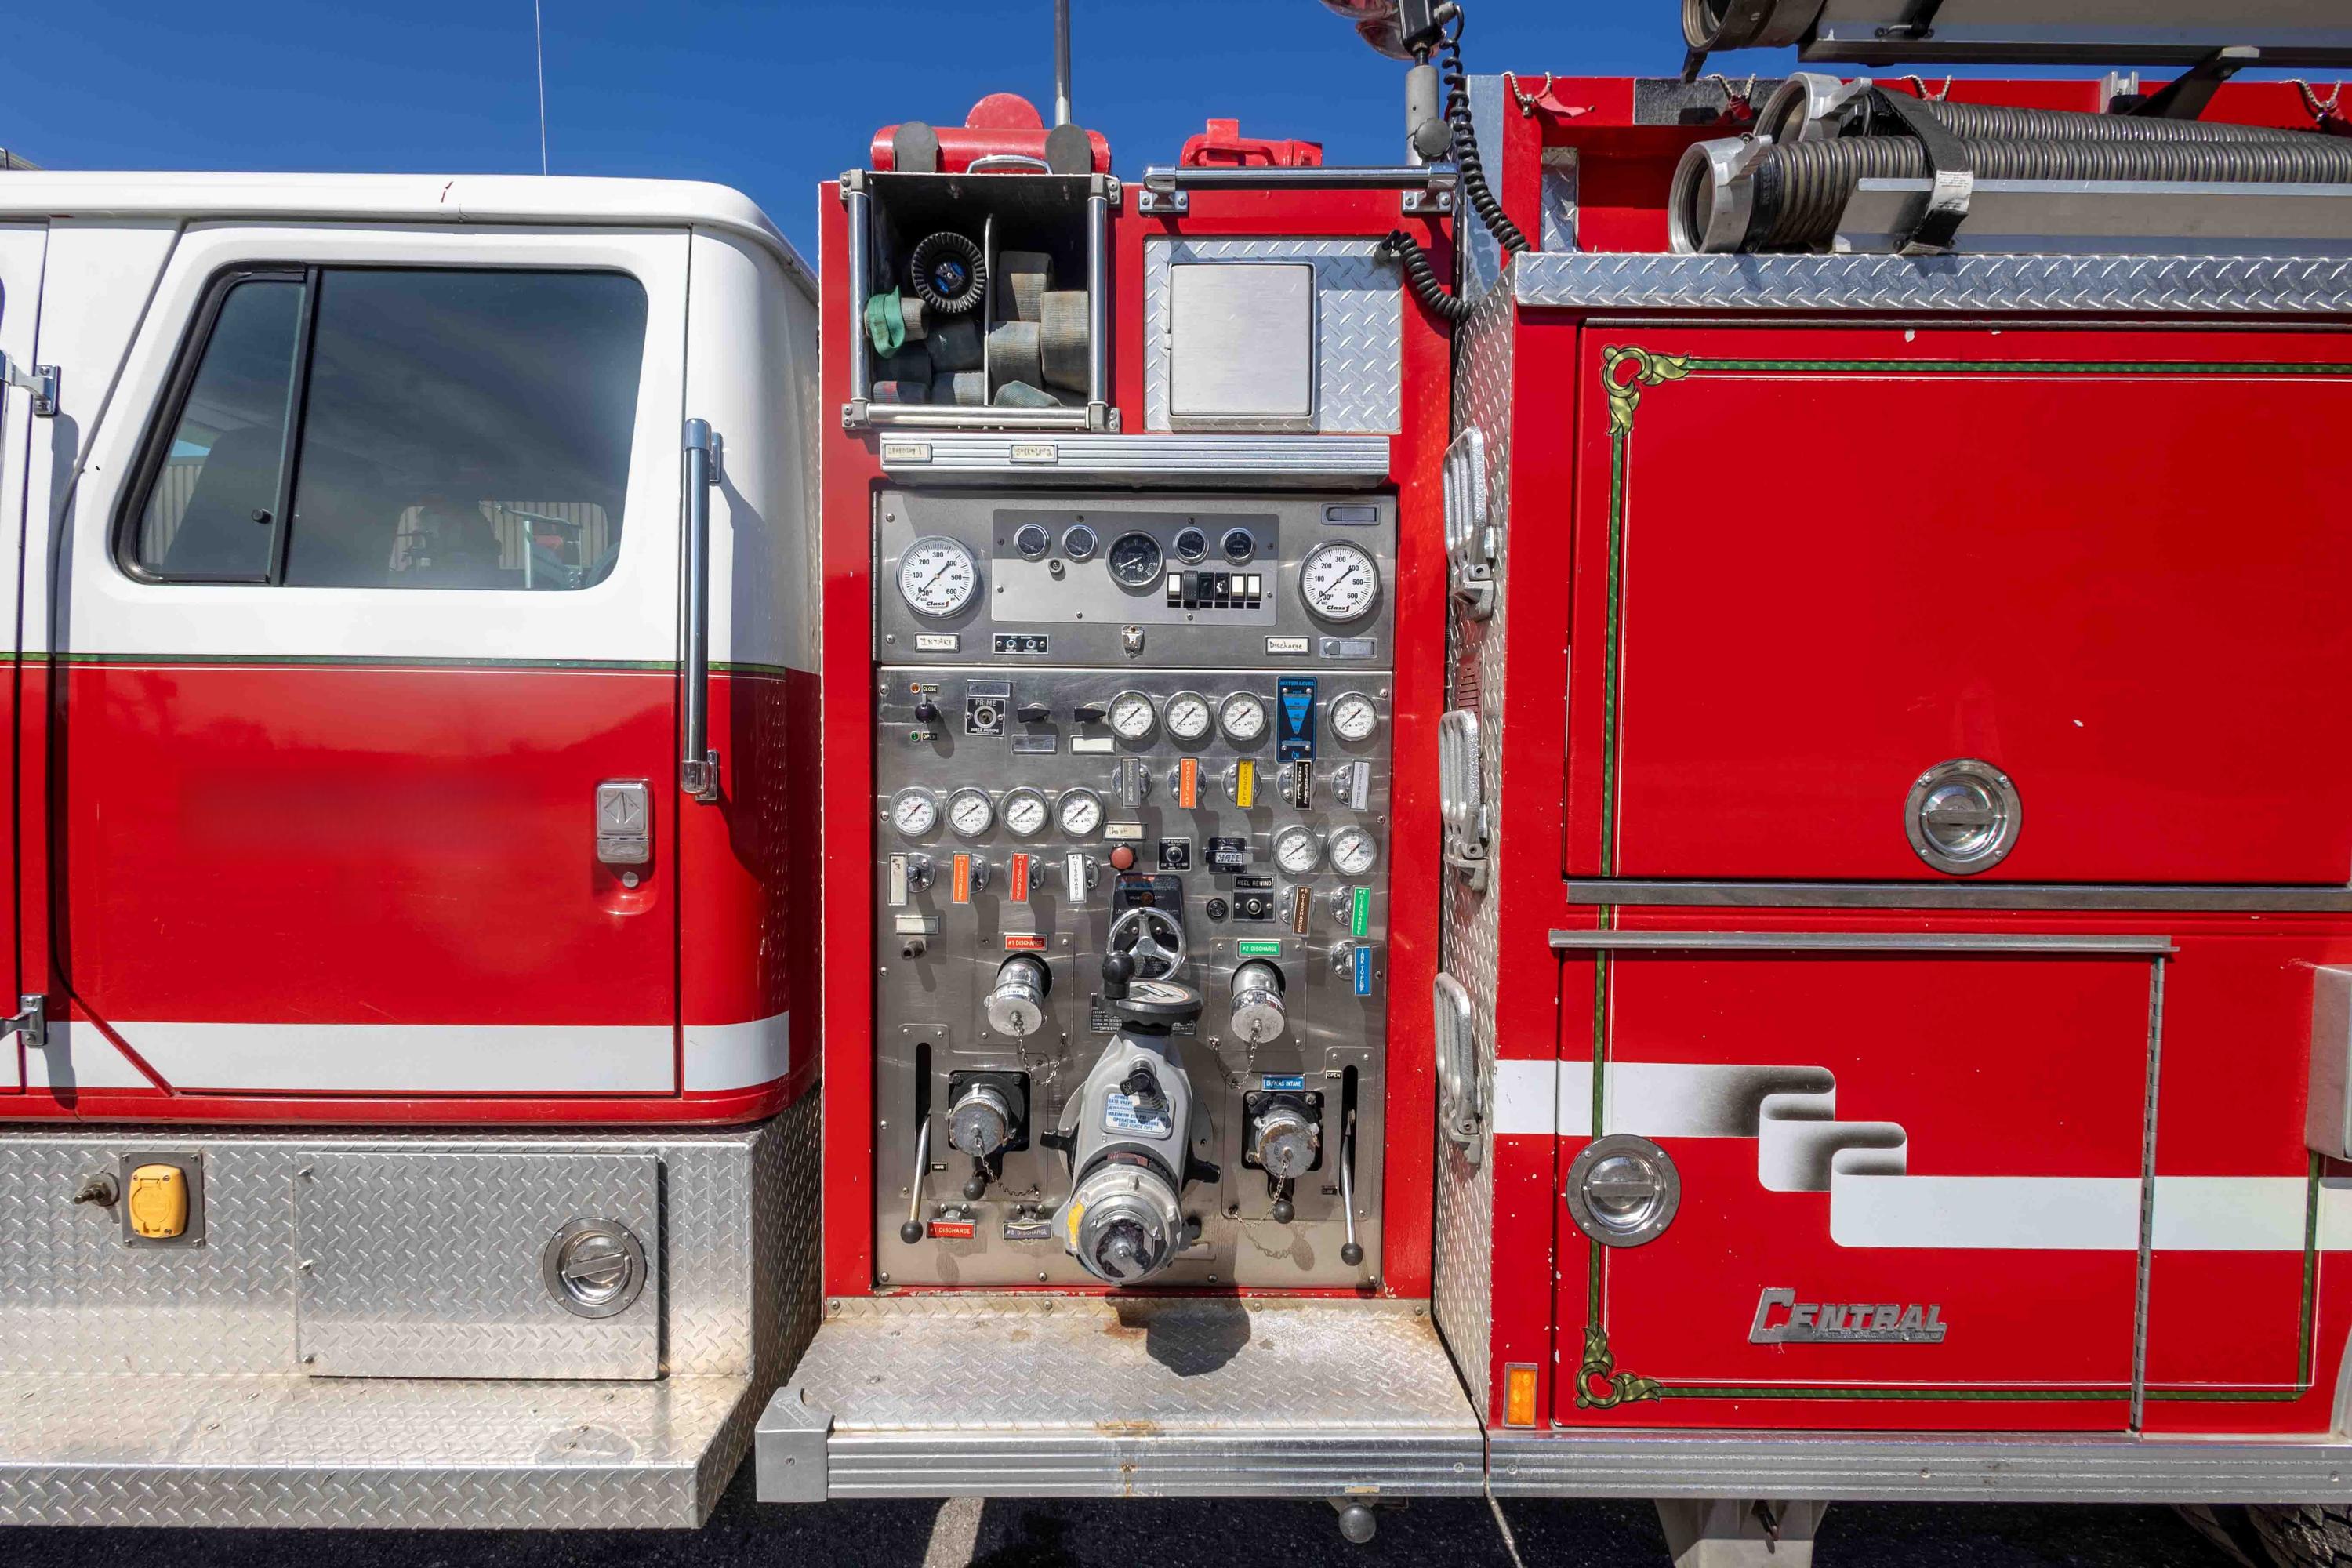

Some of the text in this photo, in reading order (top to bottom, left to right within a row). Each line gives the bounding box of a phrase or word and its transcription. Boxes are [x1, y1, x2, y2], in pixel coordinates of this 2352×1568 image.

[1269, 641, 1303, 650] Discharge
[1218, 854, 1241, 862] HALE
[1749, 1287, 1947, 1342] CENTRAL
